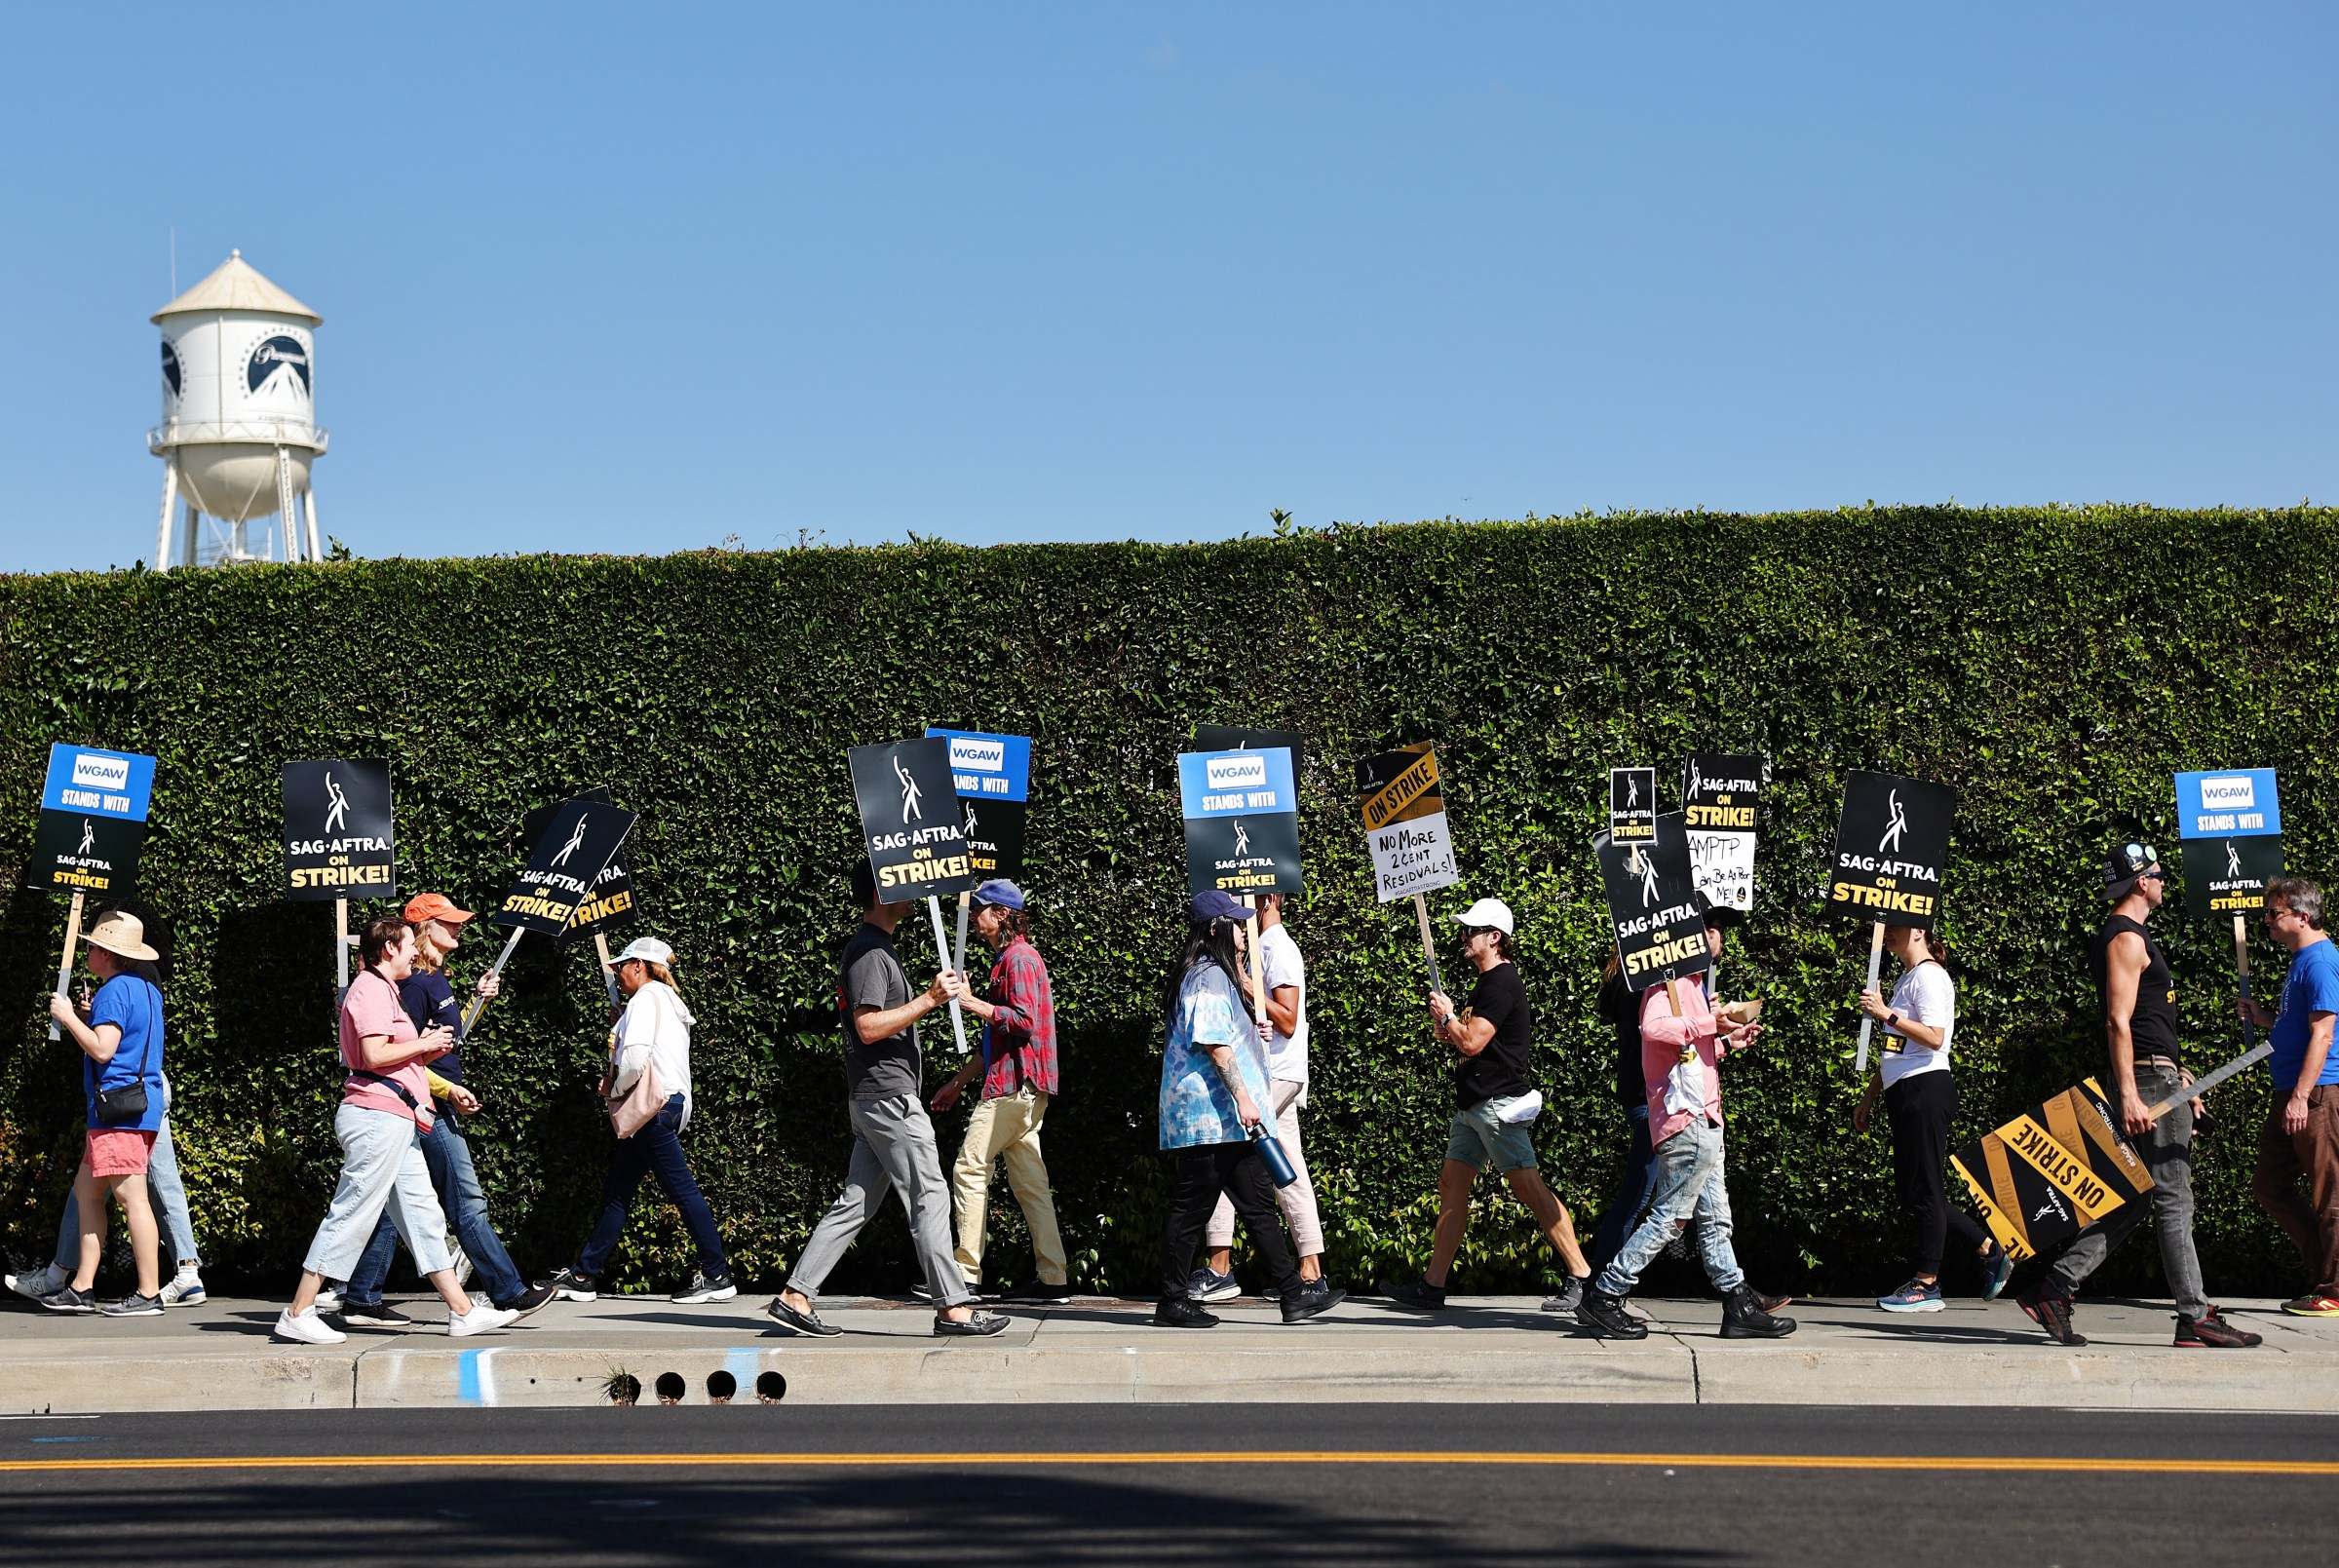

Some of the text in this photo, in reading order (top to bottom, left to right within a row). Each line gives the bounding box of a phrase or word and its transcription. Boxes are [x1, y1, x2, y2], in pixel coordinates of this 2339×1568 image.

[953, 747, 1000, 761] WGAW
[78, 763, 125, 780] WGAW
[1210, 765, 1261, 779] WGAW
[982, 777, 1009, 793] WITH
[1368, 798, 1389, 824] ON
[1386, 761, 1433, 810] STRIKE
[2205, 786, 2250, 799] WGAW
[61, 789, 130, 813] STANDS WITH
[1203, 791, 1276, 811] STANDS WITH
[1717, 794, 1731, 805] ON
[1686, 805, 1754, 827] STRIKE!
[2197, 813, 2264, 831] STANDS WITH
[1613, 825, 1653, 837] STRIKE!
[1379, 835, 1396, 852] NO
[1689, 835, 1740, 865] AMPTP
[328, 855, 348, 866] ON
[913, 848, 932, 860] ON
[76, 866, 88, 875] ON
[290, 864, 390, 887] STRIKE!
[879, 855, 970, 888] STRIKE!
[1712, 868, 1726, 884] Be
[54, 870, 109, 889] STRIKE!
[1216, 874, 1276, 890] STRIKE!
[1875, 876, 1897, 890] ON
[535, 887, 550, 898] ON
[1832, 882, 1934, 916] STRIKE!
[502, 895, 573, 922] STRIKE!
[570, 891, 633, 928] TRIKE!
[2210, 896, 2264, 910] STRIKE!
[1653, 930, 1670, 943] ON
[1626, 933, 1706, 975] STRIKE!
[2012, 1123, 2079, 1187] STRIKE
[2072, 1176, 2105, 1209] ON
[1905, 1294, 1925, 1303] HOKA
